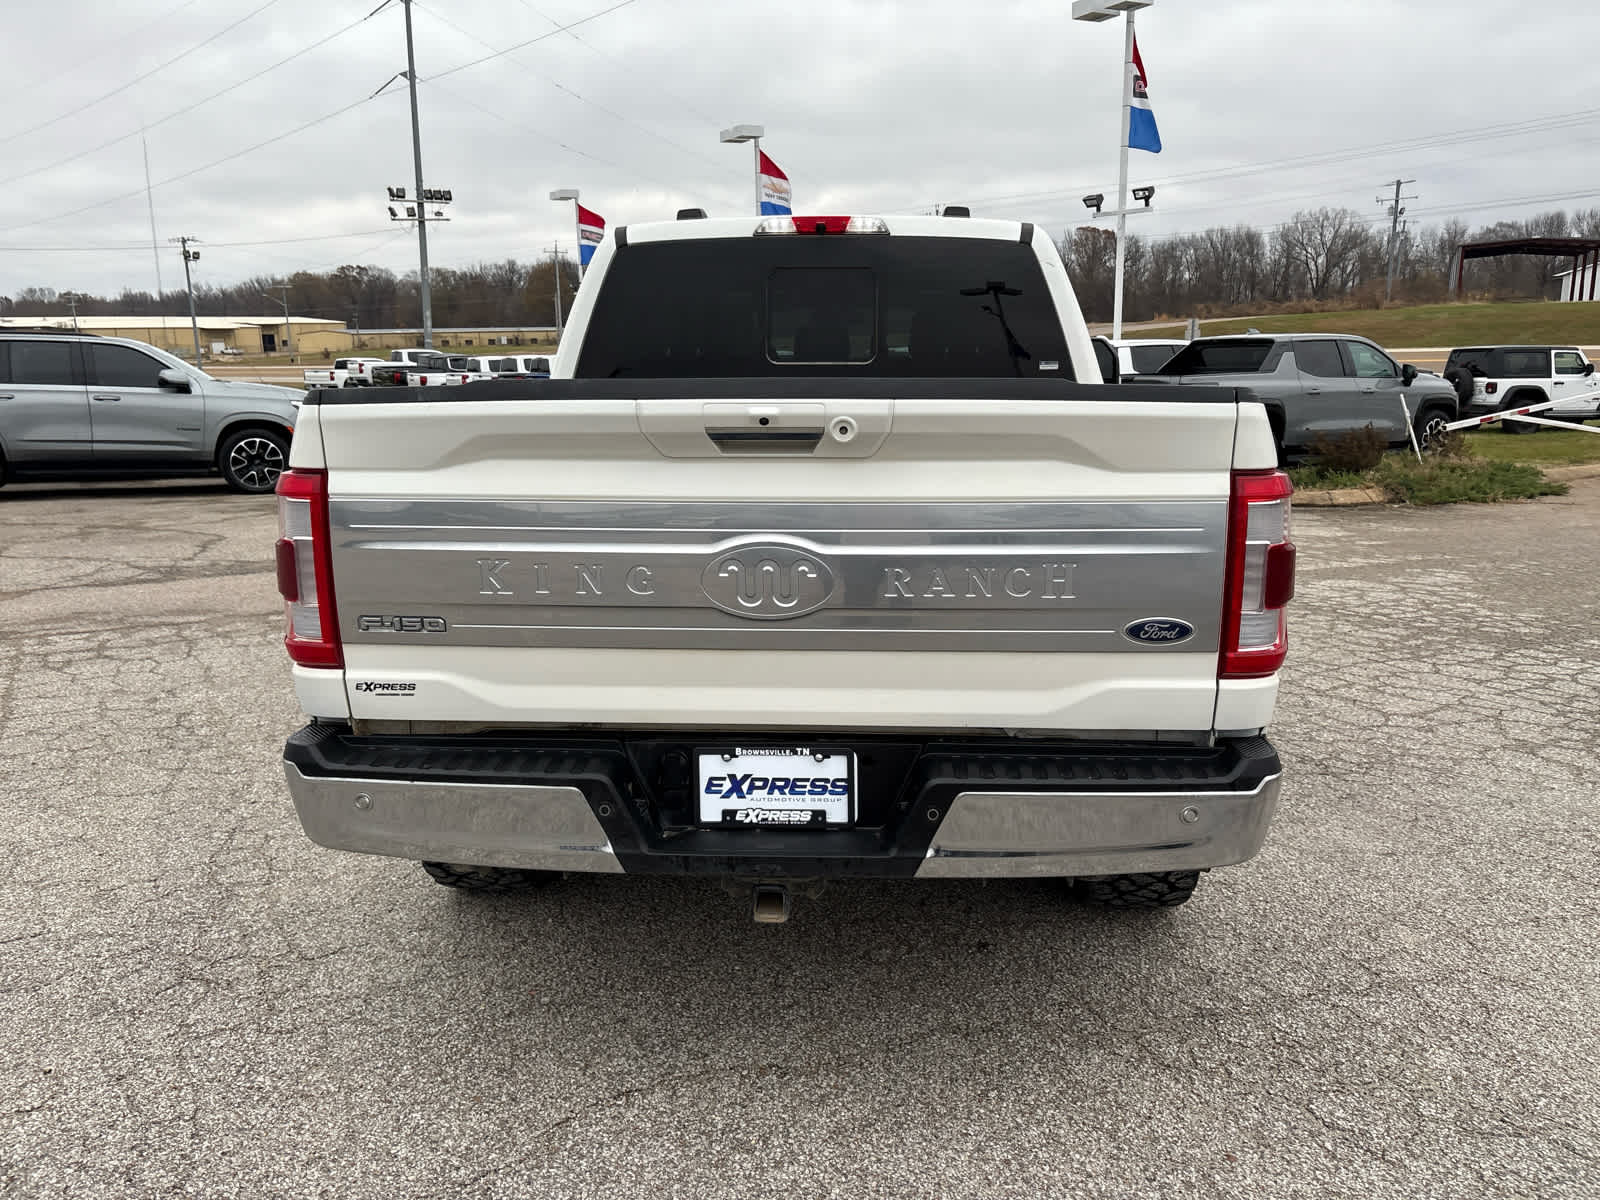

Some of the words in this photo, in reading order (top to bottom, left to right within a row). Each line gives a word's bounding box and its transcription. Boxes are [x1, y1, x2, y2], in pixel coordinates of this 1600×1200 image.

[476, 558, 655, 595] KING
[883, 560, 1080, 600] RANCH
[357, 615, 447, 633] F-150
[1140, 622, 1180, 639] Ford
[355, 681, 417, 692] EXPRESS
[796, 747, 810, 756] TN
[704, 773, 848, 799] EXPRESS
[735, 807, 812, 823] EXPRESS
